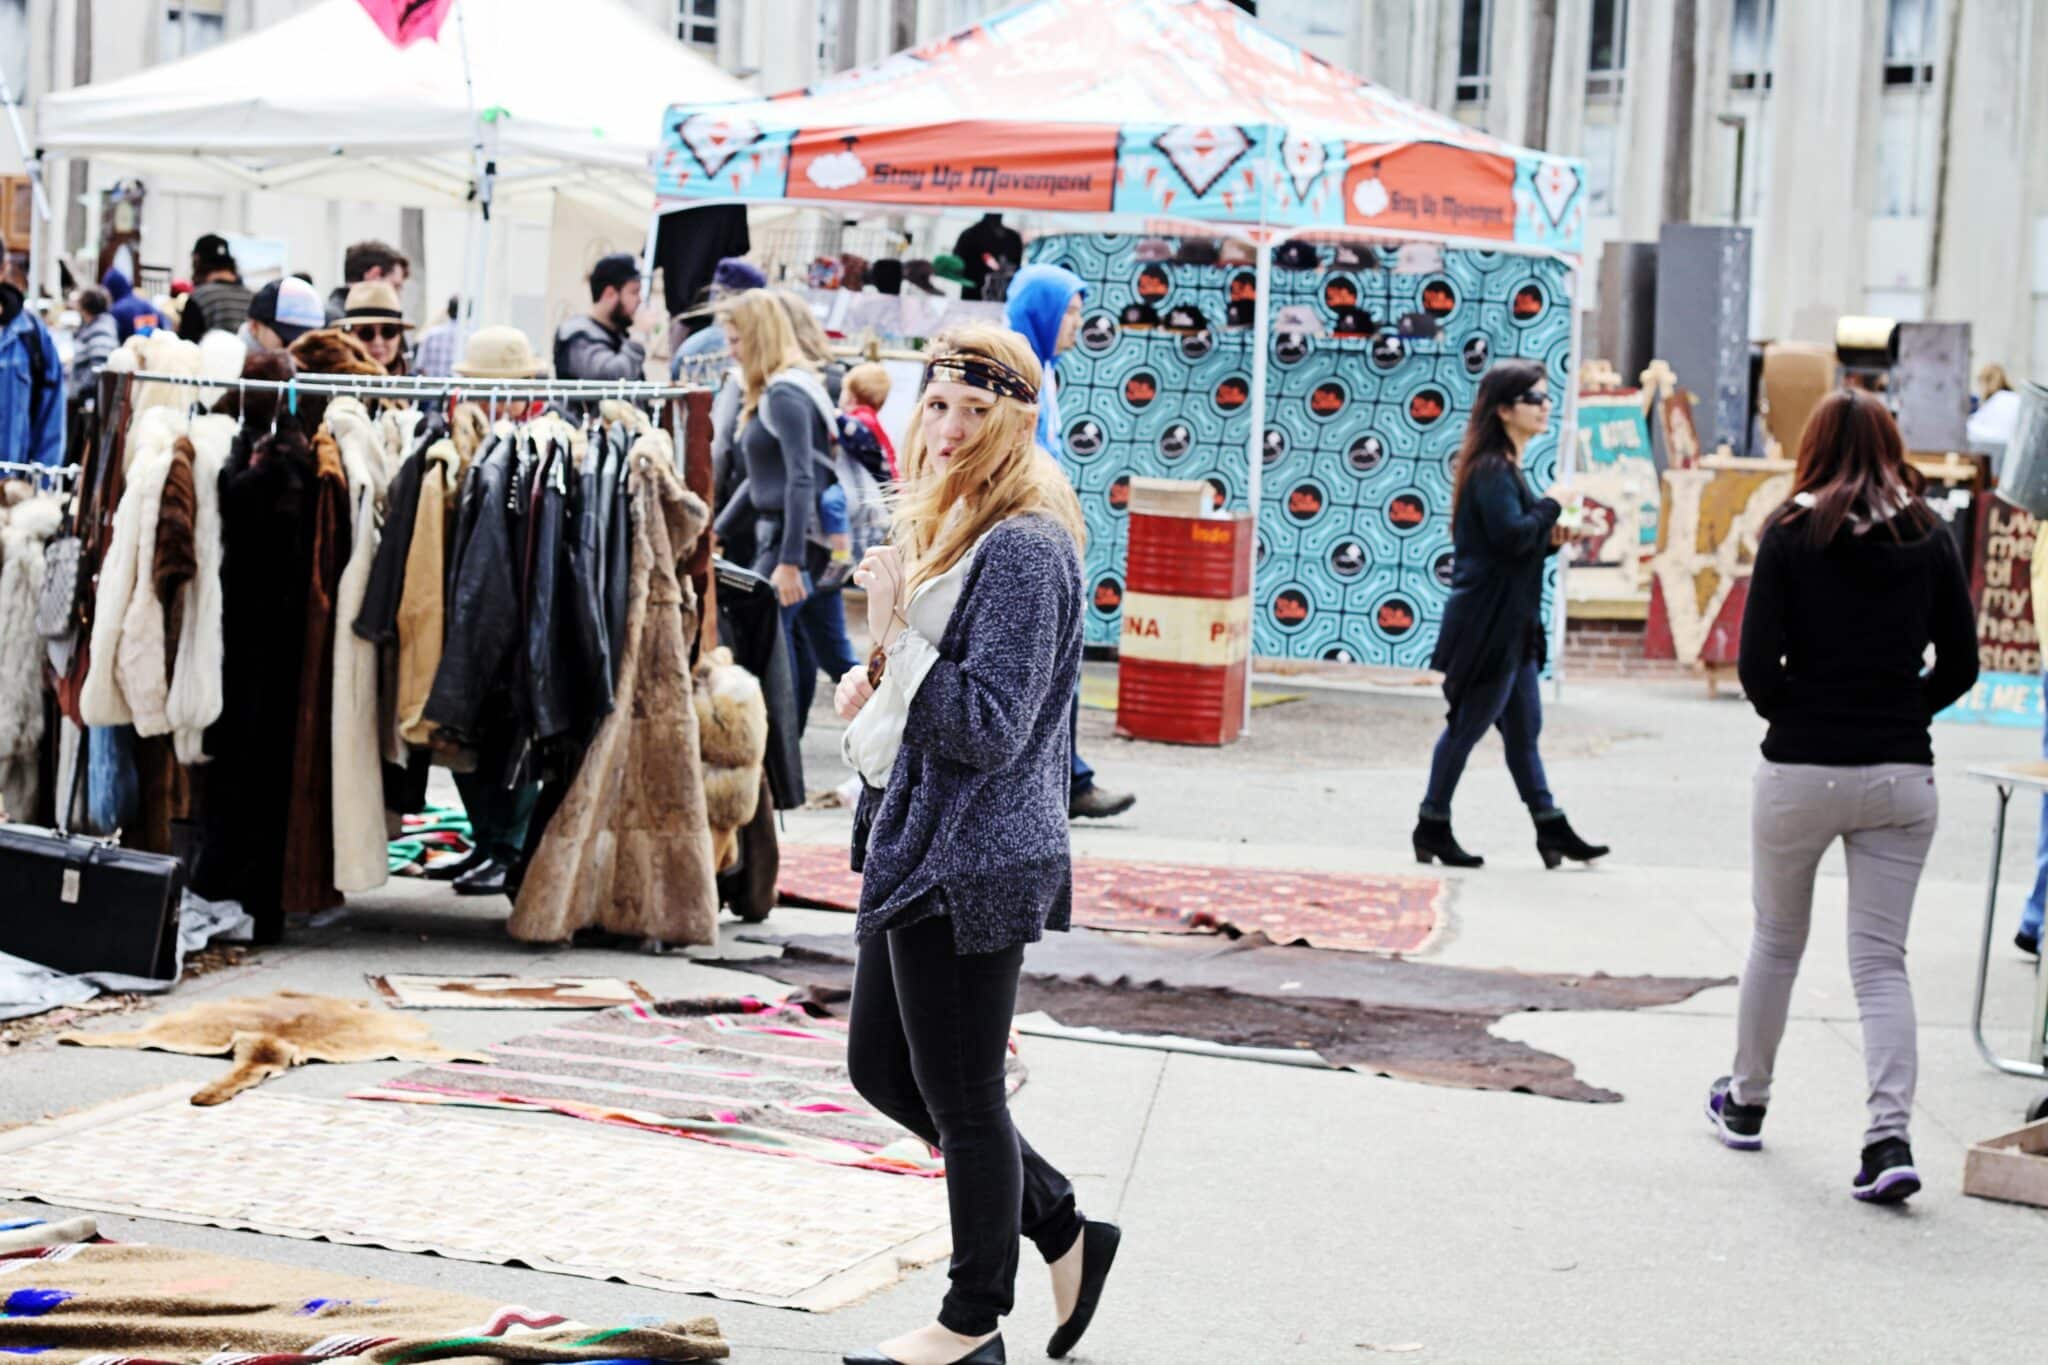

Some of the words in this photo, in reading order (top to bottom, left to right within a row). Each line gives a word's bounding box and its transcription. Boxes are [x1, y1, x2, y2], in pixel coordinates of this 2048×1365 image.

[874, 163, 924, 191] Stay
[932, 163, 963, 192] Up
[969, 164, 1092, 196] Movement
[1989, 506, 2039, 534] Lov
